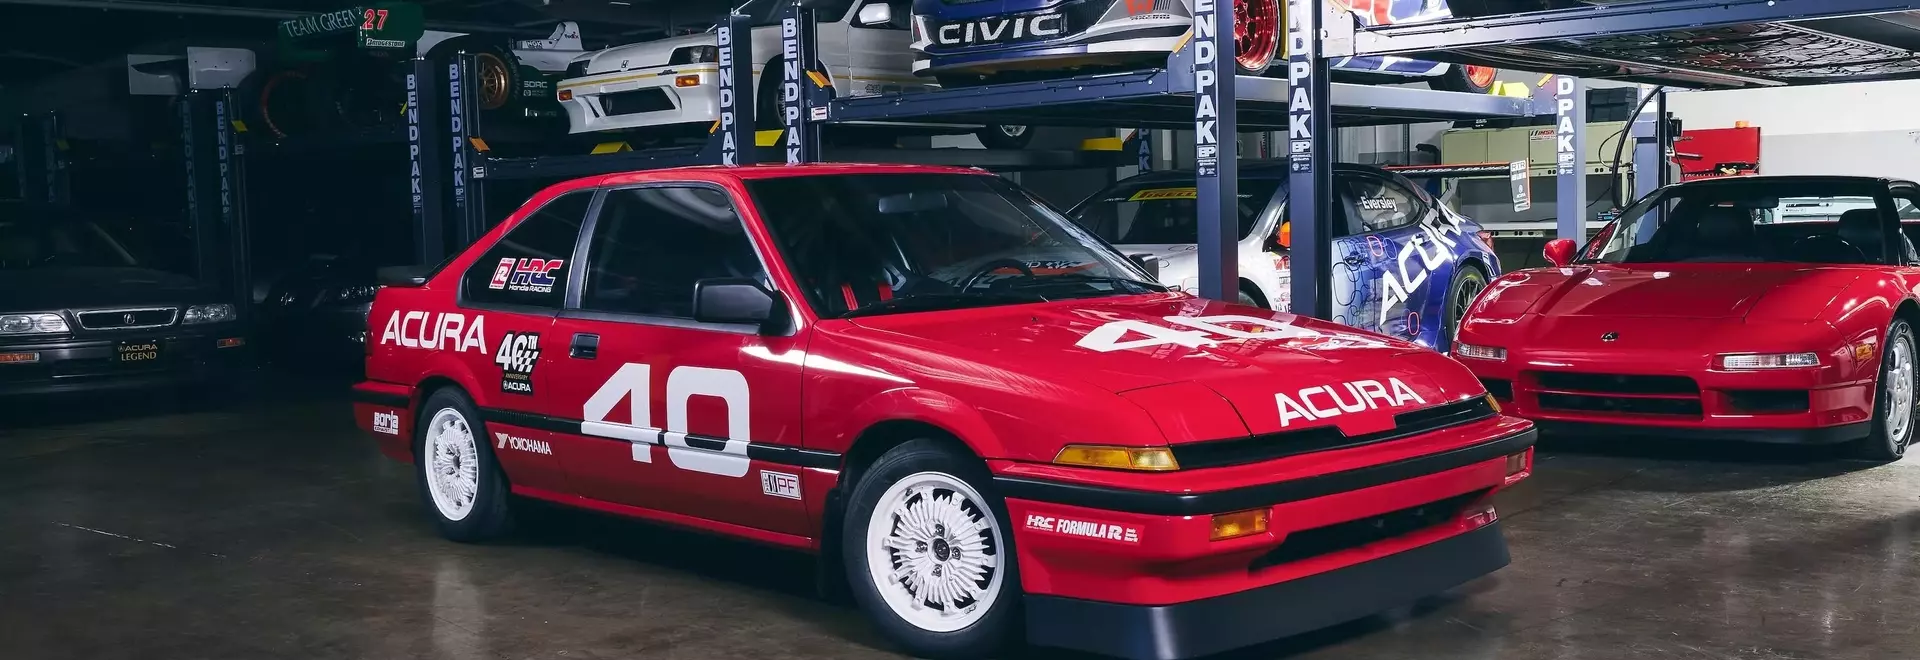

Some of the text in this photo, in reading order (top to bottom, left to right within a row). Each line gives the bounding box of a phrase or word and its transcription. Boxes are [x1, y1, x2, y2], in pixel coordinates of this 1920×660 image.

[284, 16, 317, 37] TEAM
[363, 9, 388, 29] 27
[939, 13, 1062, 44] CIVIC
[717, 26, 736, 165] BENDPAK
[783, 18, 800, 165] BENDPAK
[449, 64, 464, 187] BENDPAK
[1557, 77, 1575, 153] DPAK
[406, 74, 421, 194] BENDPAK
[1292, 142, 1310, 152] BP
[216, 100, 230, 206] BENDPAK
[1198, 147, 1216, 157] BP
[1361, 197, 1397, 211] Eversley
[510, 258, 564, 286] HRC
[1380, 198, 1466, 326] ACURA
[509, 284, 528, 292] Honda
[380, 310, 487, 354] ACURA
[121, 352, 157, 361] LEGEND
[508, 382, 532, 391] ACURA
[1274, 377, 1426, 427] ACURA
[580, 362, 751, 478] 40
[507, 438, 552, 455] YOKOHAMA
[1026, 515, 1055, 528] HRC
[1056, 519, 1106, 538] FORMULA
[1107, 525, 1123, 540] R
